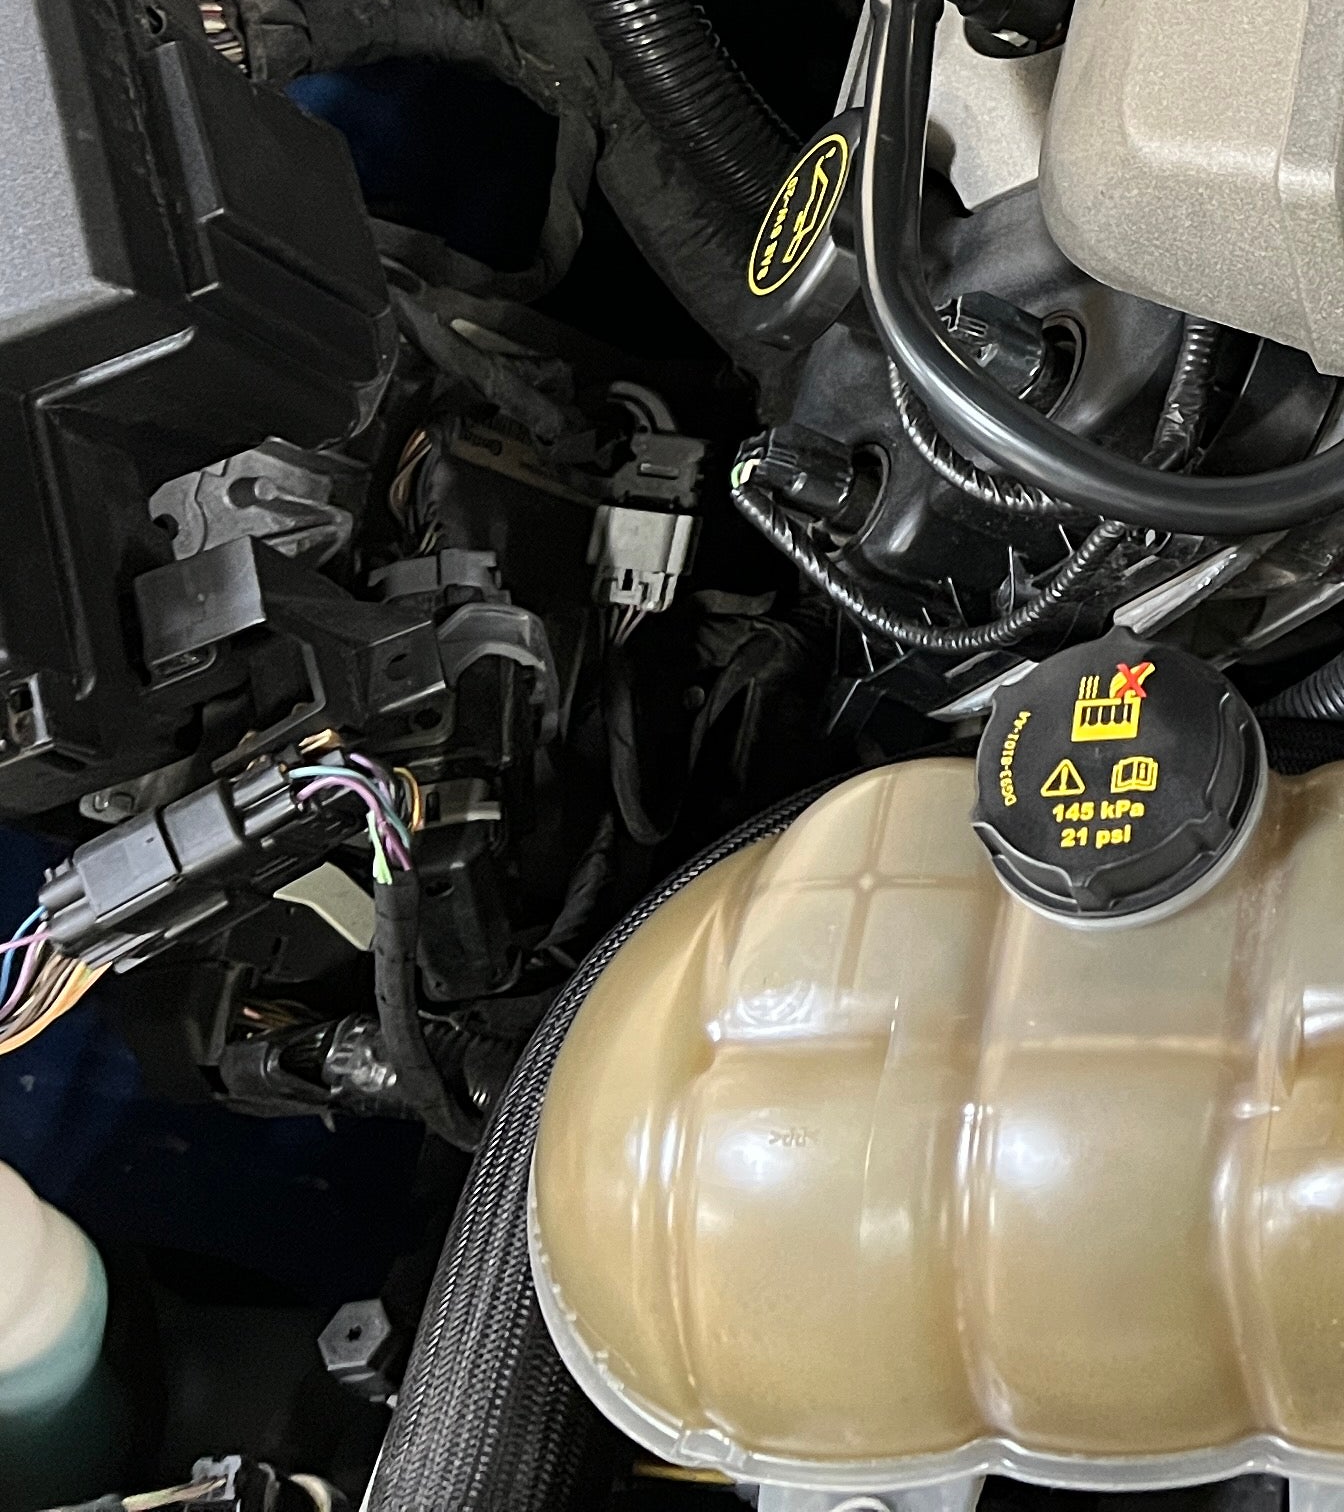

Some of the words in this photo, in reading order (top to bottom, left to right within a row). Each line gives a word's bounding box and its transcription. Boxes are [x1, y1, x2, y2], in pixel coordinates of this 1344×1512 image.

[1000, 711, 1031, 806] DG93-8101-AA
[1053, 801, 1094, 823] 145
[1100, 800, 1145, 819] kPa
[1061, 827, 1088, 848] 21
[1096, 825, 1131, 849] psi
